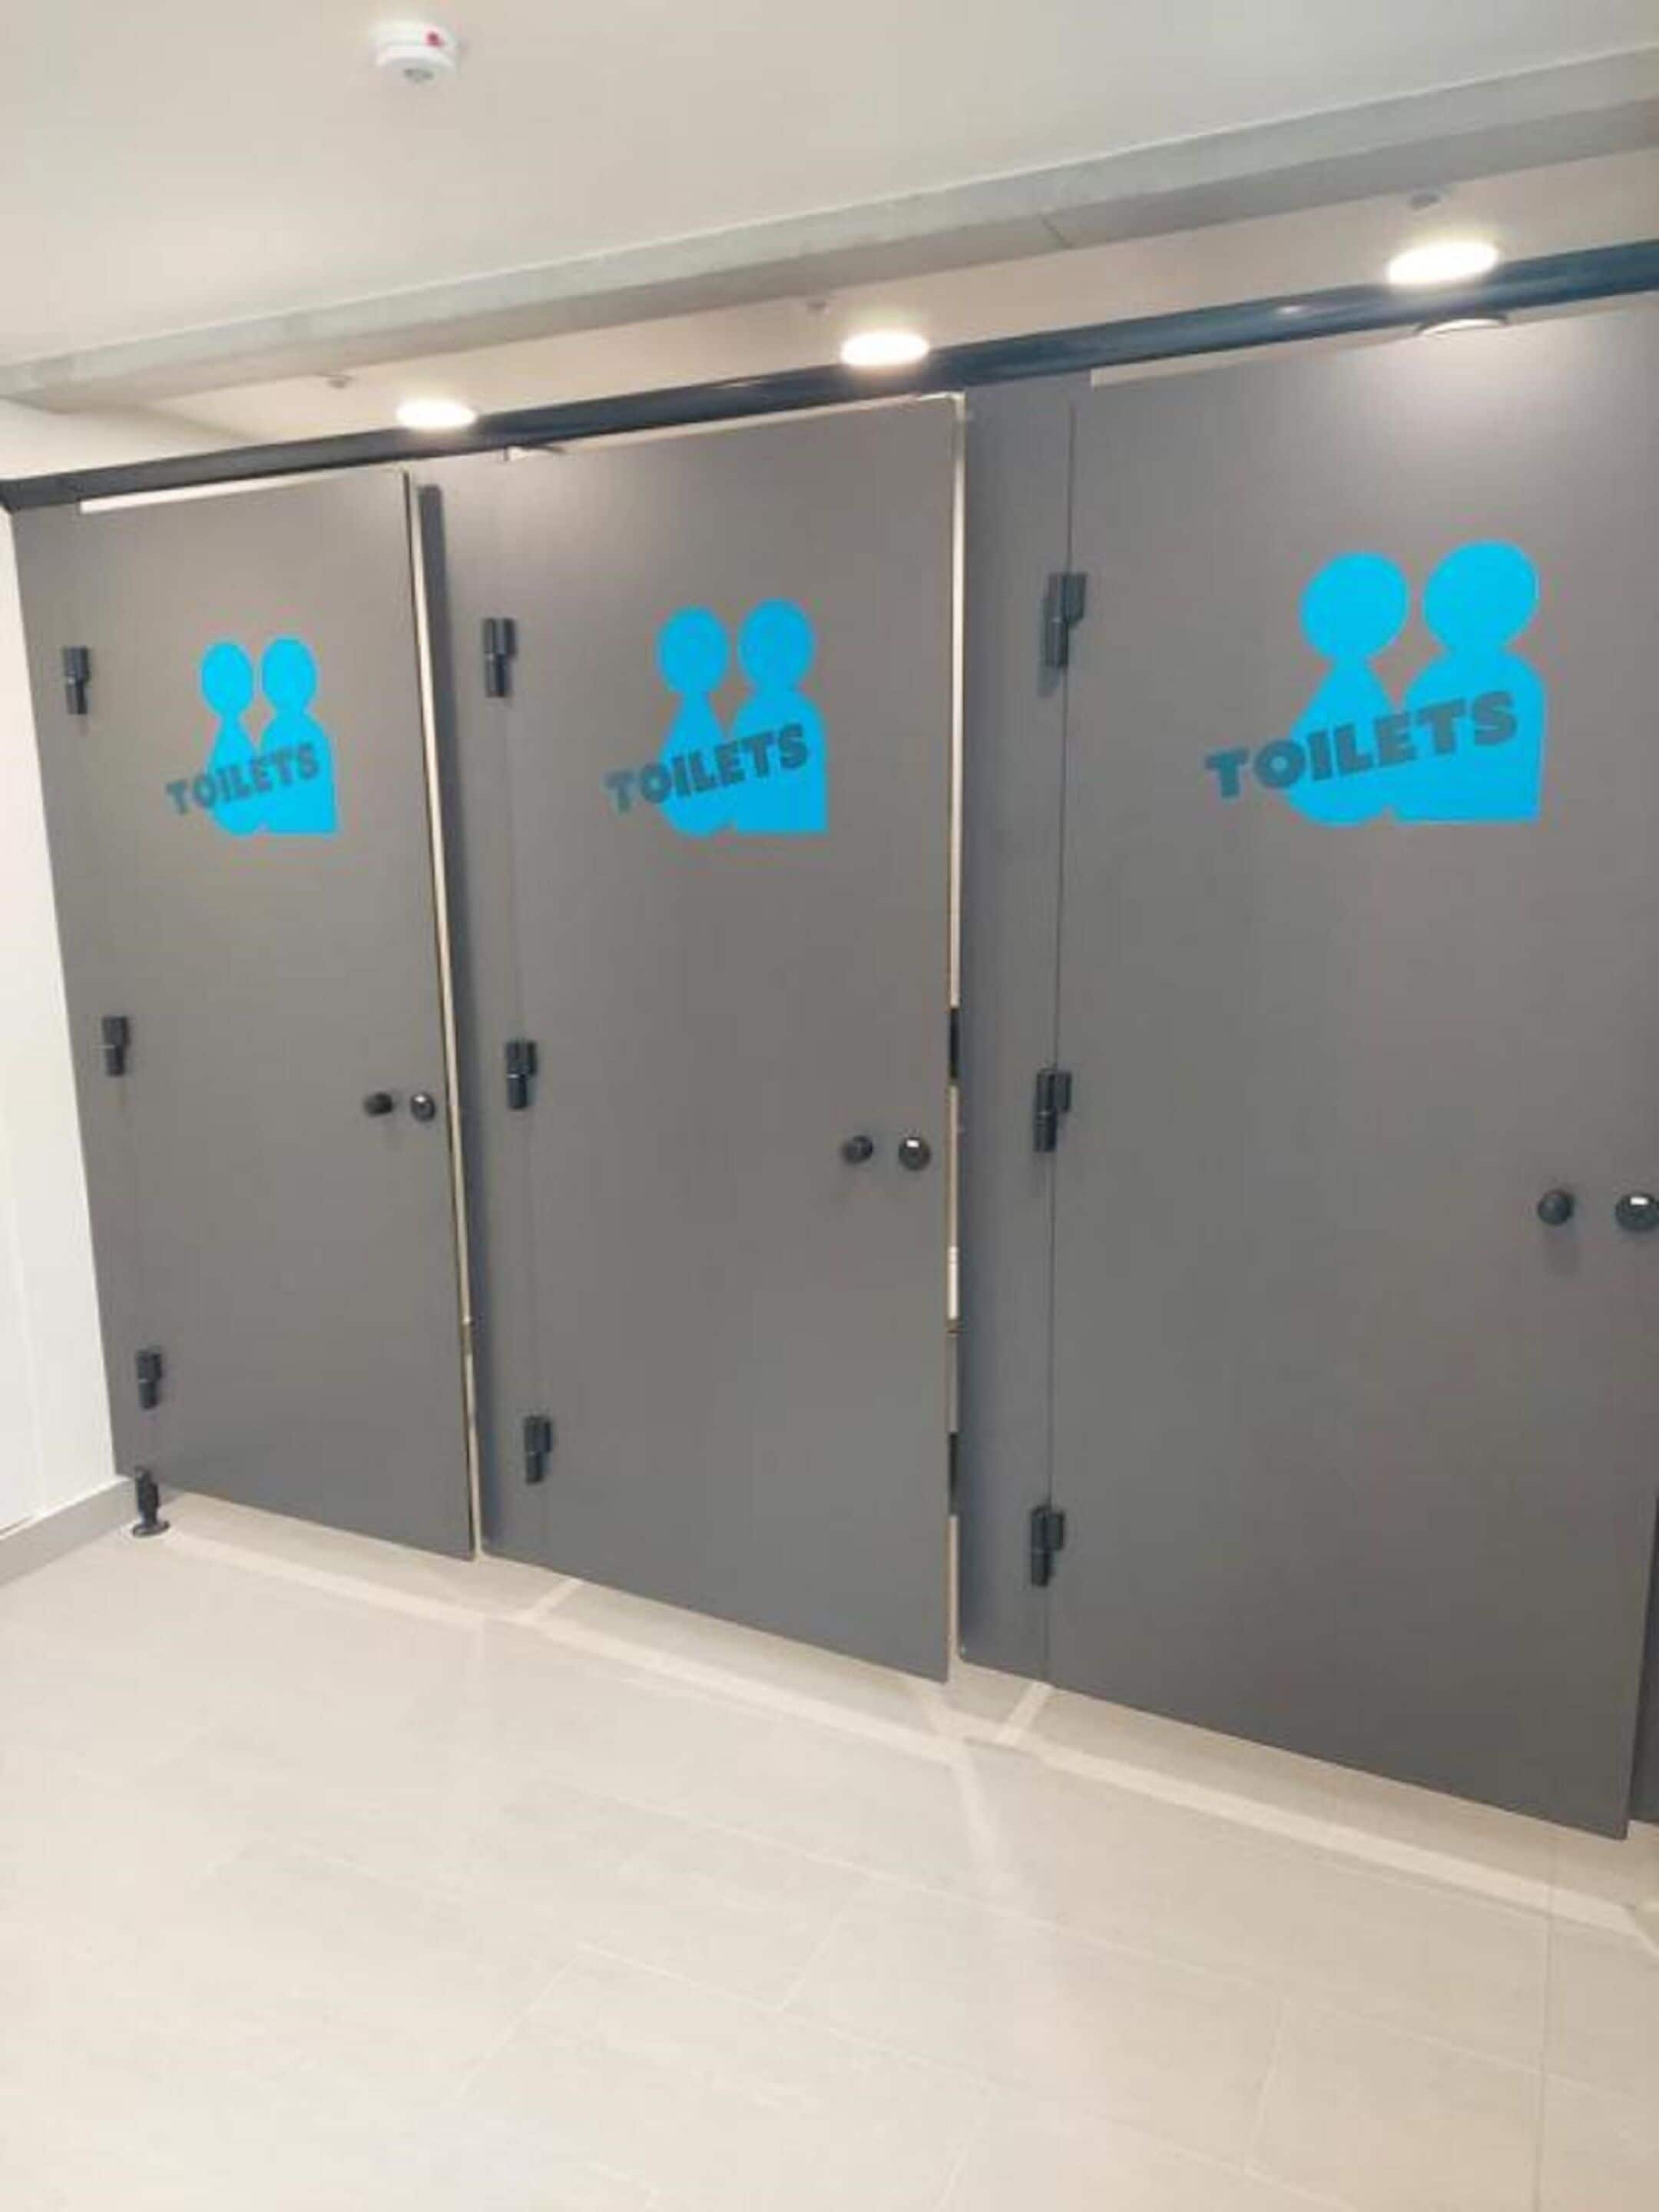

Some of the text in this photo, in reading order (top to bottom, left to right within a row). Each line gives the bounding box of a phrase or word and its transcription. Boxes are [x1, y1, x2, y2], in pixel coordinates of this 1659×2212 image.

[164, 742, 320, 815] TOILETS
[605, 724, 808, 813] TOILETS
[1205, 690, 1519, 799] TOILETS
